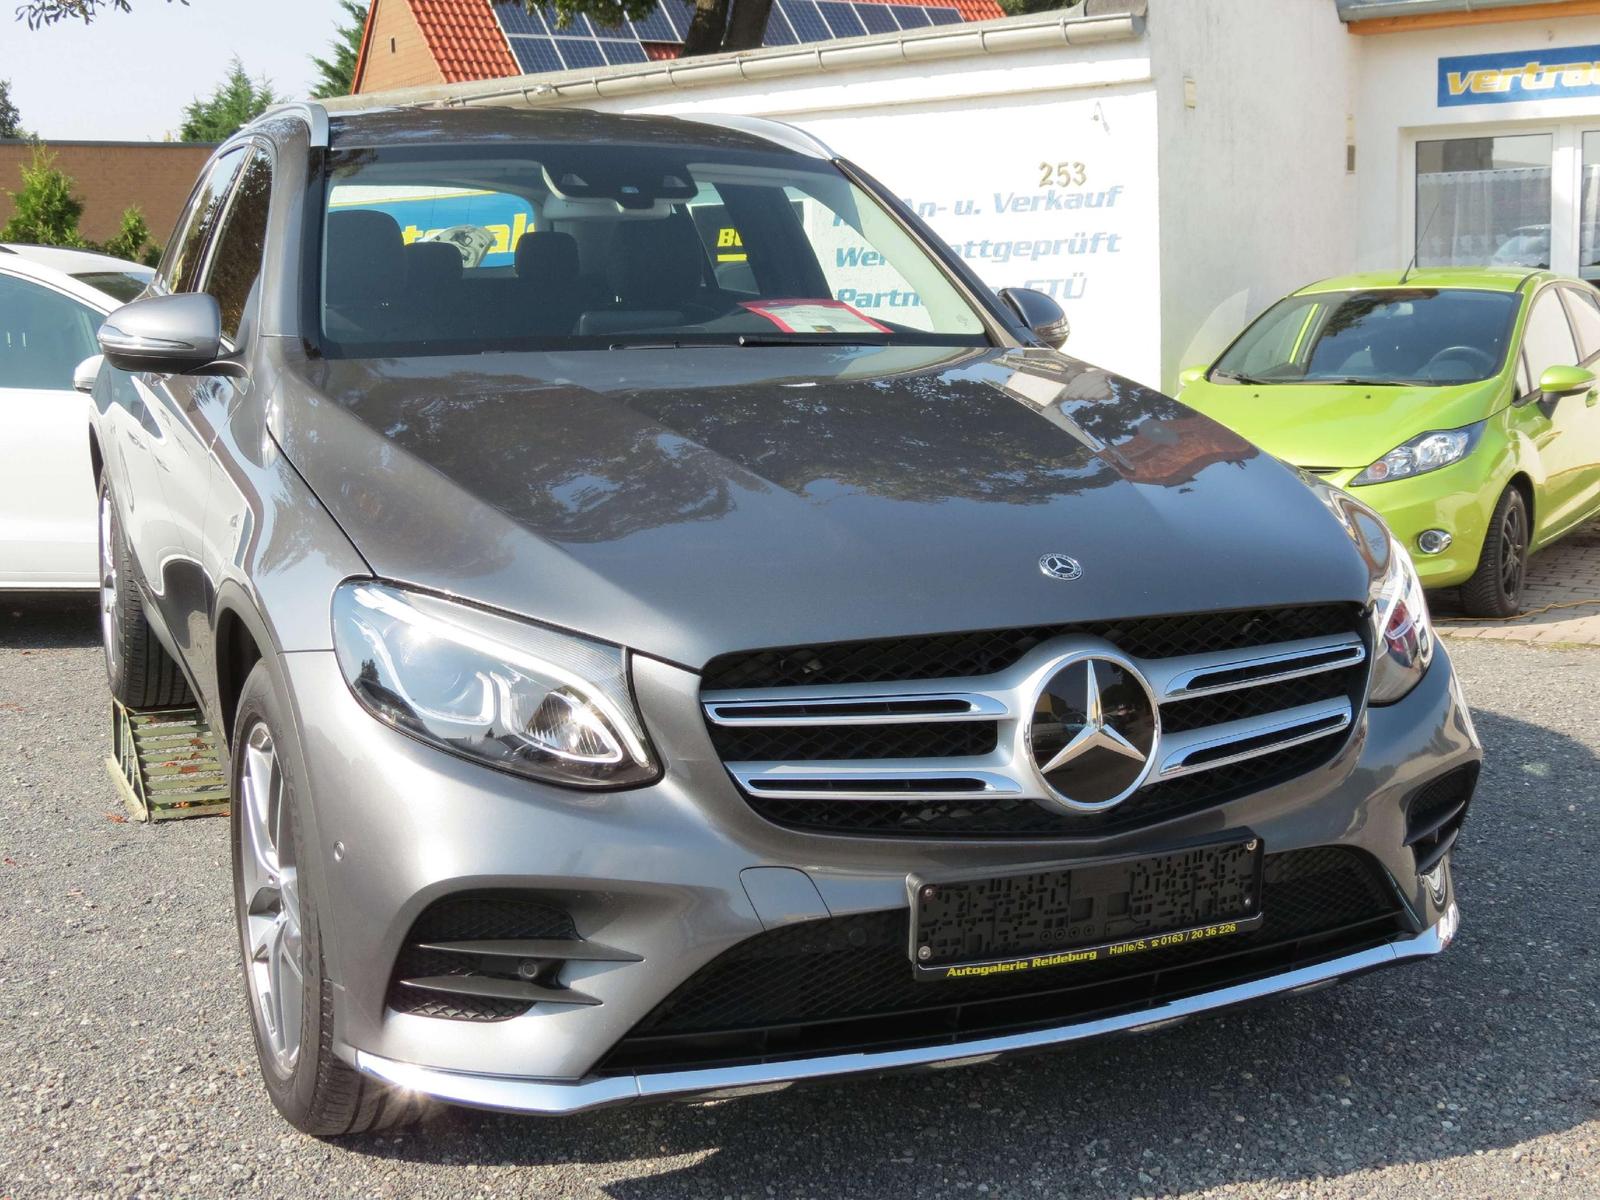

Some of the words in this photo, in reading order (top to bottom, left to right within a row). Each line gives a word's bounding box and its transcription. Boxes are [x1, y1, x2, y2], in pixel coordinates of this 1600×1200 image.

[1038, 162, 1088, 188] 253
[993, 185, 1125, 214] Verkauf
[946, 961, 1029, 977] Autogalerie
[1032, 950, 1098, 968] Reideburg
[1109, 942, 1148, 955] Halle/S.
[1161, 934, 1184, 945] 0163
[1191, 930, 1204, 939] 20
[1205, 927, 1217, 936] 36
[1219, 923, 1237, 934] 226
